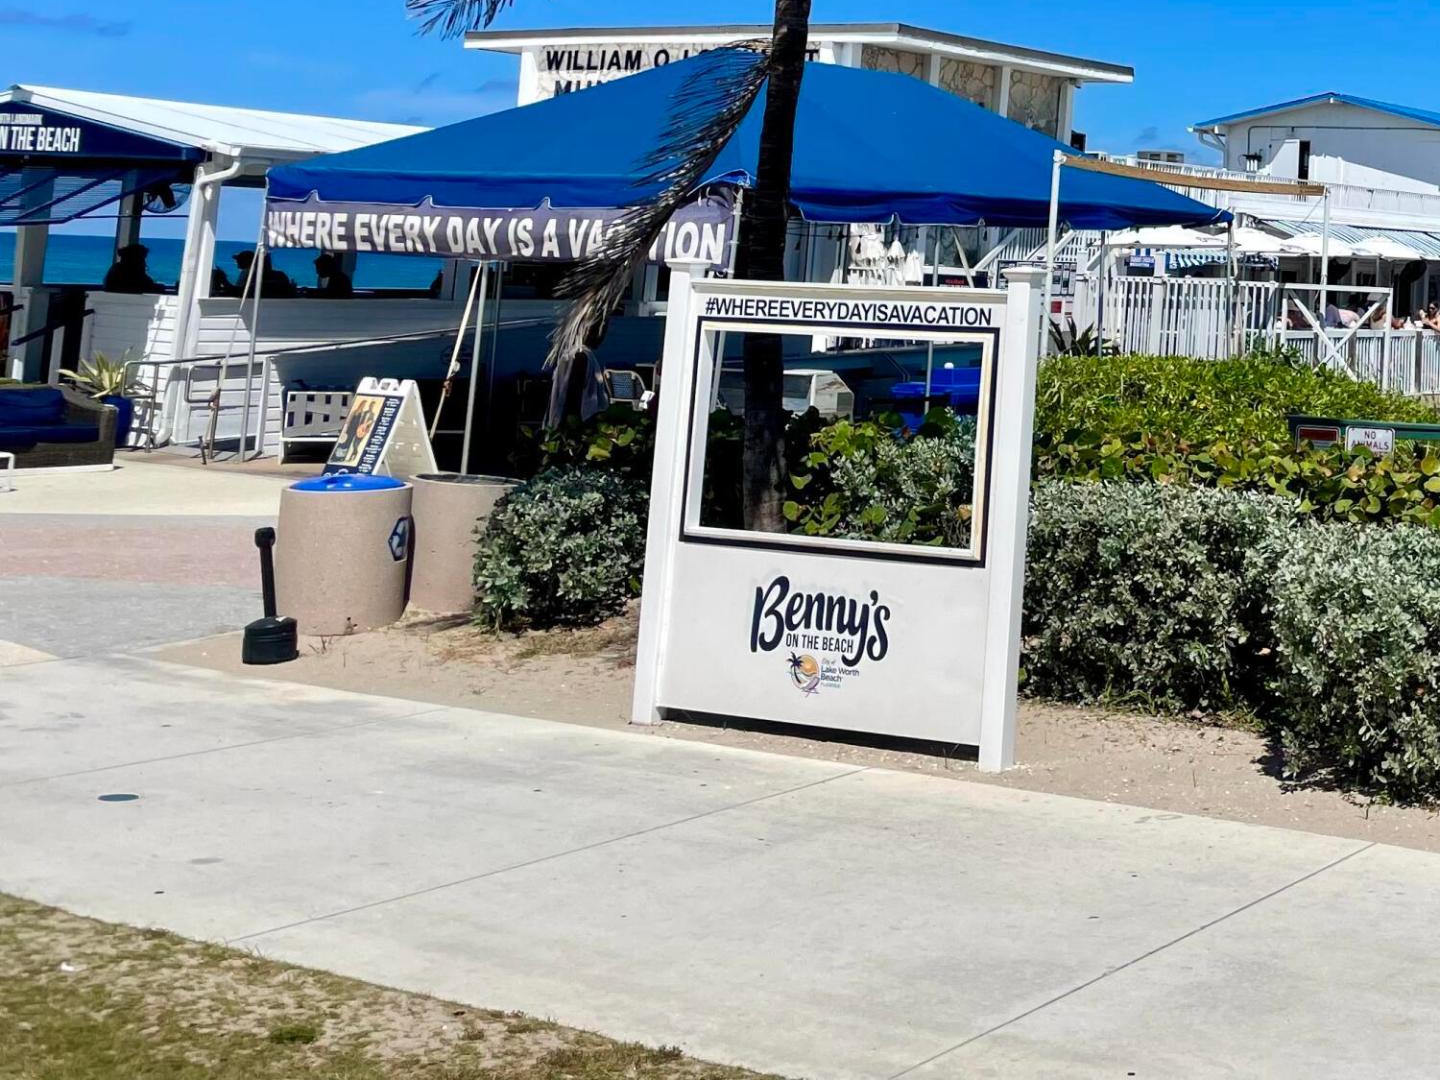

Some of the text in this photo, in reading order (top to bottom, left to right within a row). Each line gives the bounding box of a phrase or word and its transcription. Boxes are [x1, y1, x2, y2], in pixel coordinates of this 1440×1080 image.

[546, 49, 642, 70] WILLIAM
[11, 127, 36, 151] THE
[36, 127, 81, 152] BEACH
[268, 211, 726, 264] WHERE EVERY DAY IS A VATION
[705, 297, 993, 326] #WHEREEVERYDAYISAVACATION
[1364, 430, 1377, 440] NO
[750, 575, 891, 667] Benny's
[785, 633, 854, 654] ON THE BEACH
[820, 673, 843, 683] Beach
[821, 664, 860, 678] Lake Worth
